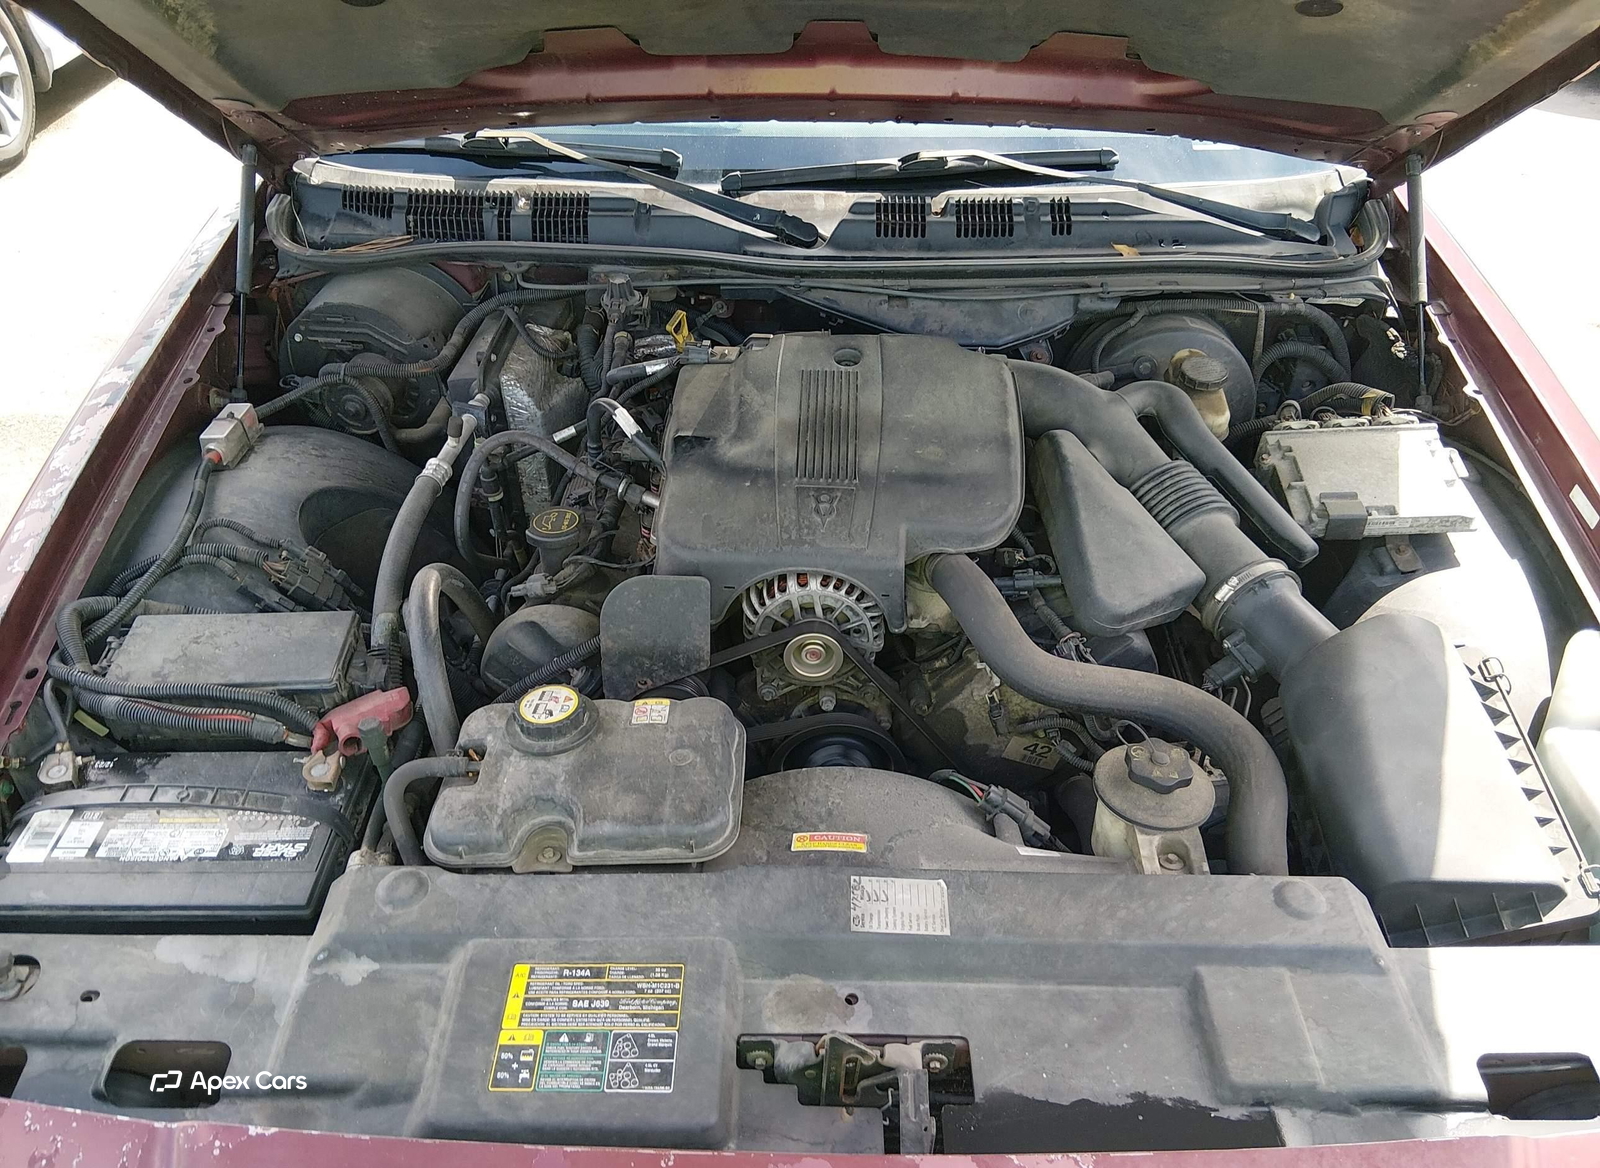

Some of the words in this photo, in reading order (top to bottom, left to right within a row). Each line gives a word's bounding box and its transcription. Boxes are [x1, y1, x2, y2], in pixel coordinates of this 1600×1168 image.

[1023, 742, 1053, 759] 42
[814, 834, 861, 842] CAUTION
[260, 843, 308, 852] START
[253, 848, 297, 858] SUPER
[563, 968, 591, 977] R-134A
[572, 999, 589, 1008] SAE
[590, 999, 609, 1008] J639
